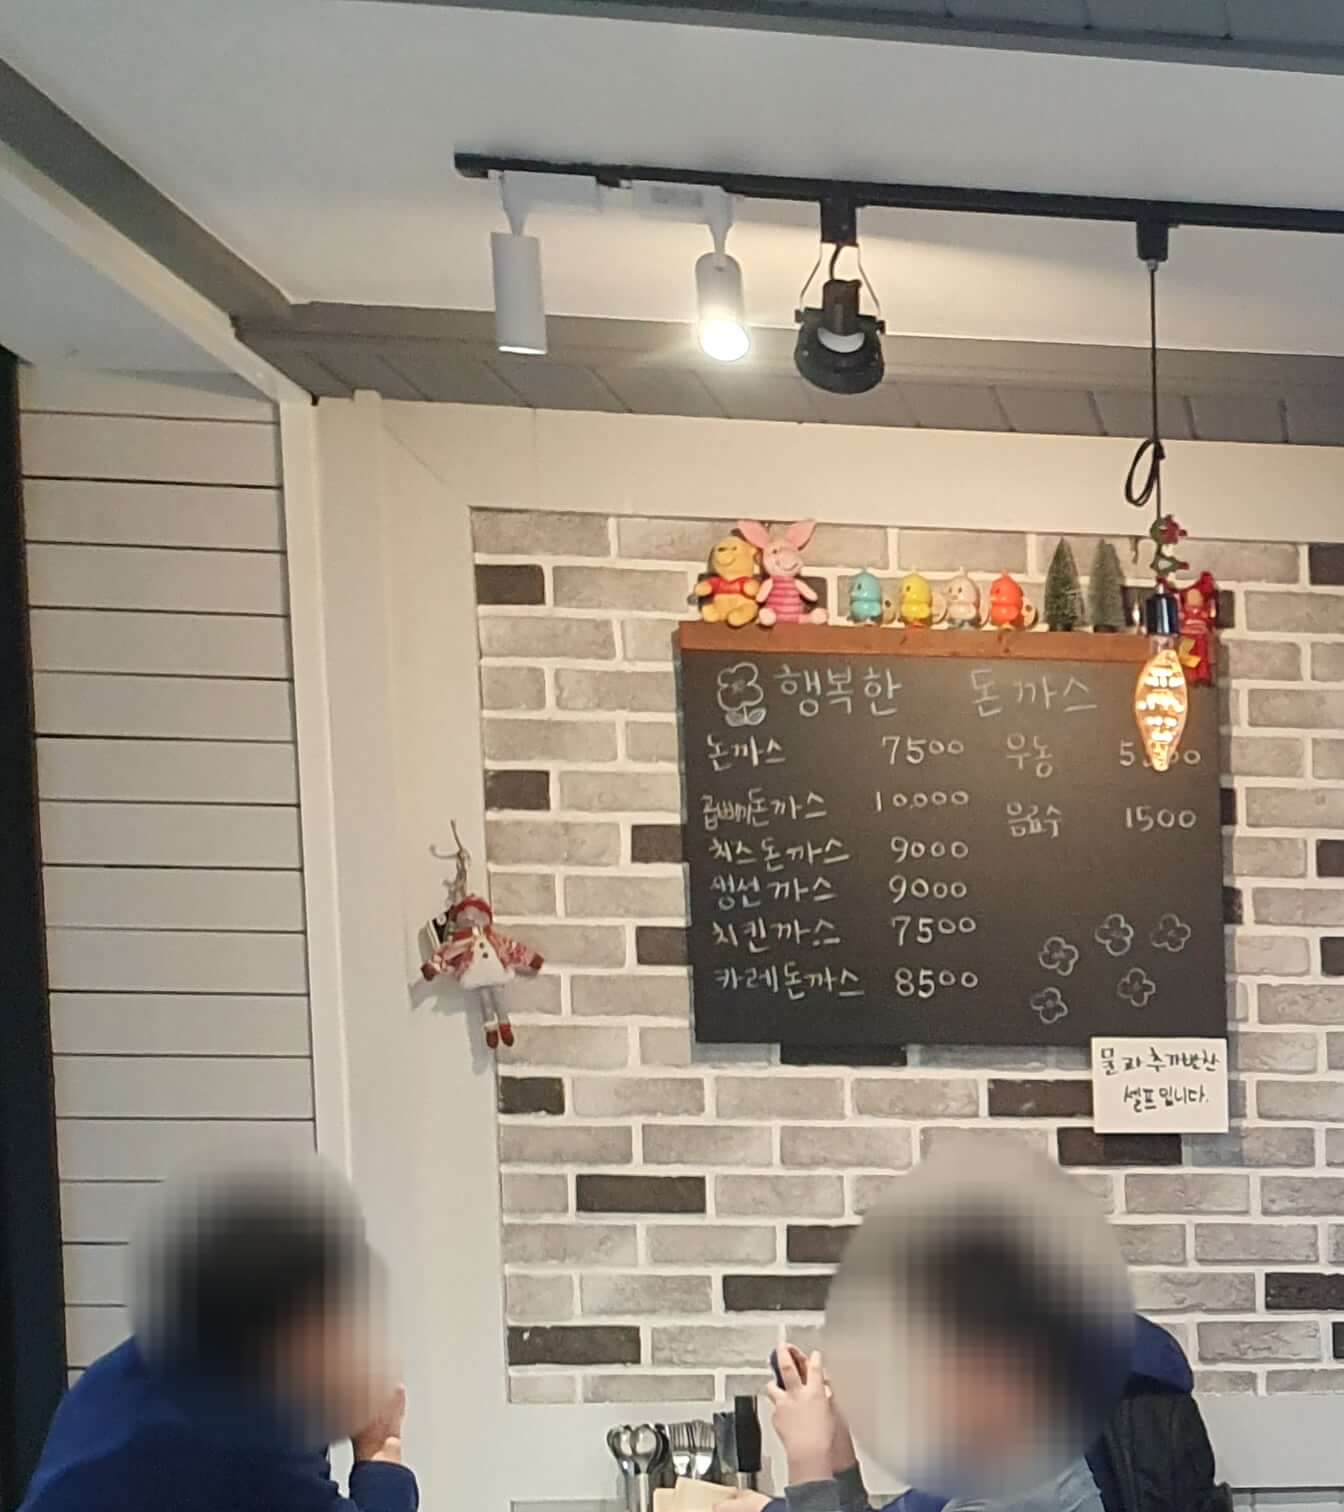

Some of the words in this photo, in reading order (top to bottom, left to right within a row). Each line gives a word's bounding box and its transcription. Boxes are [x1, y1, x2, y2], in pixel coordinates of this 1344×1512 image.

[774, 664, 902, 717] 행복한
[971, 669, 1097, 717] 돈까스
[882, 735, 964, 765] 7500
[1006, 801, 1063, 838] 음료수
[1125, 805, 1197, 832] 1500
[890, 836, 969, 863] 9000
[889, 874, 967, 904] 9000
[712, 916, 841, 953] 치킨까스
[891, 915, 976, 947] 7500
[713, 961, 864, 1000] 카레돈까스
[894, 967, 979, 998] 8500
